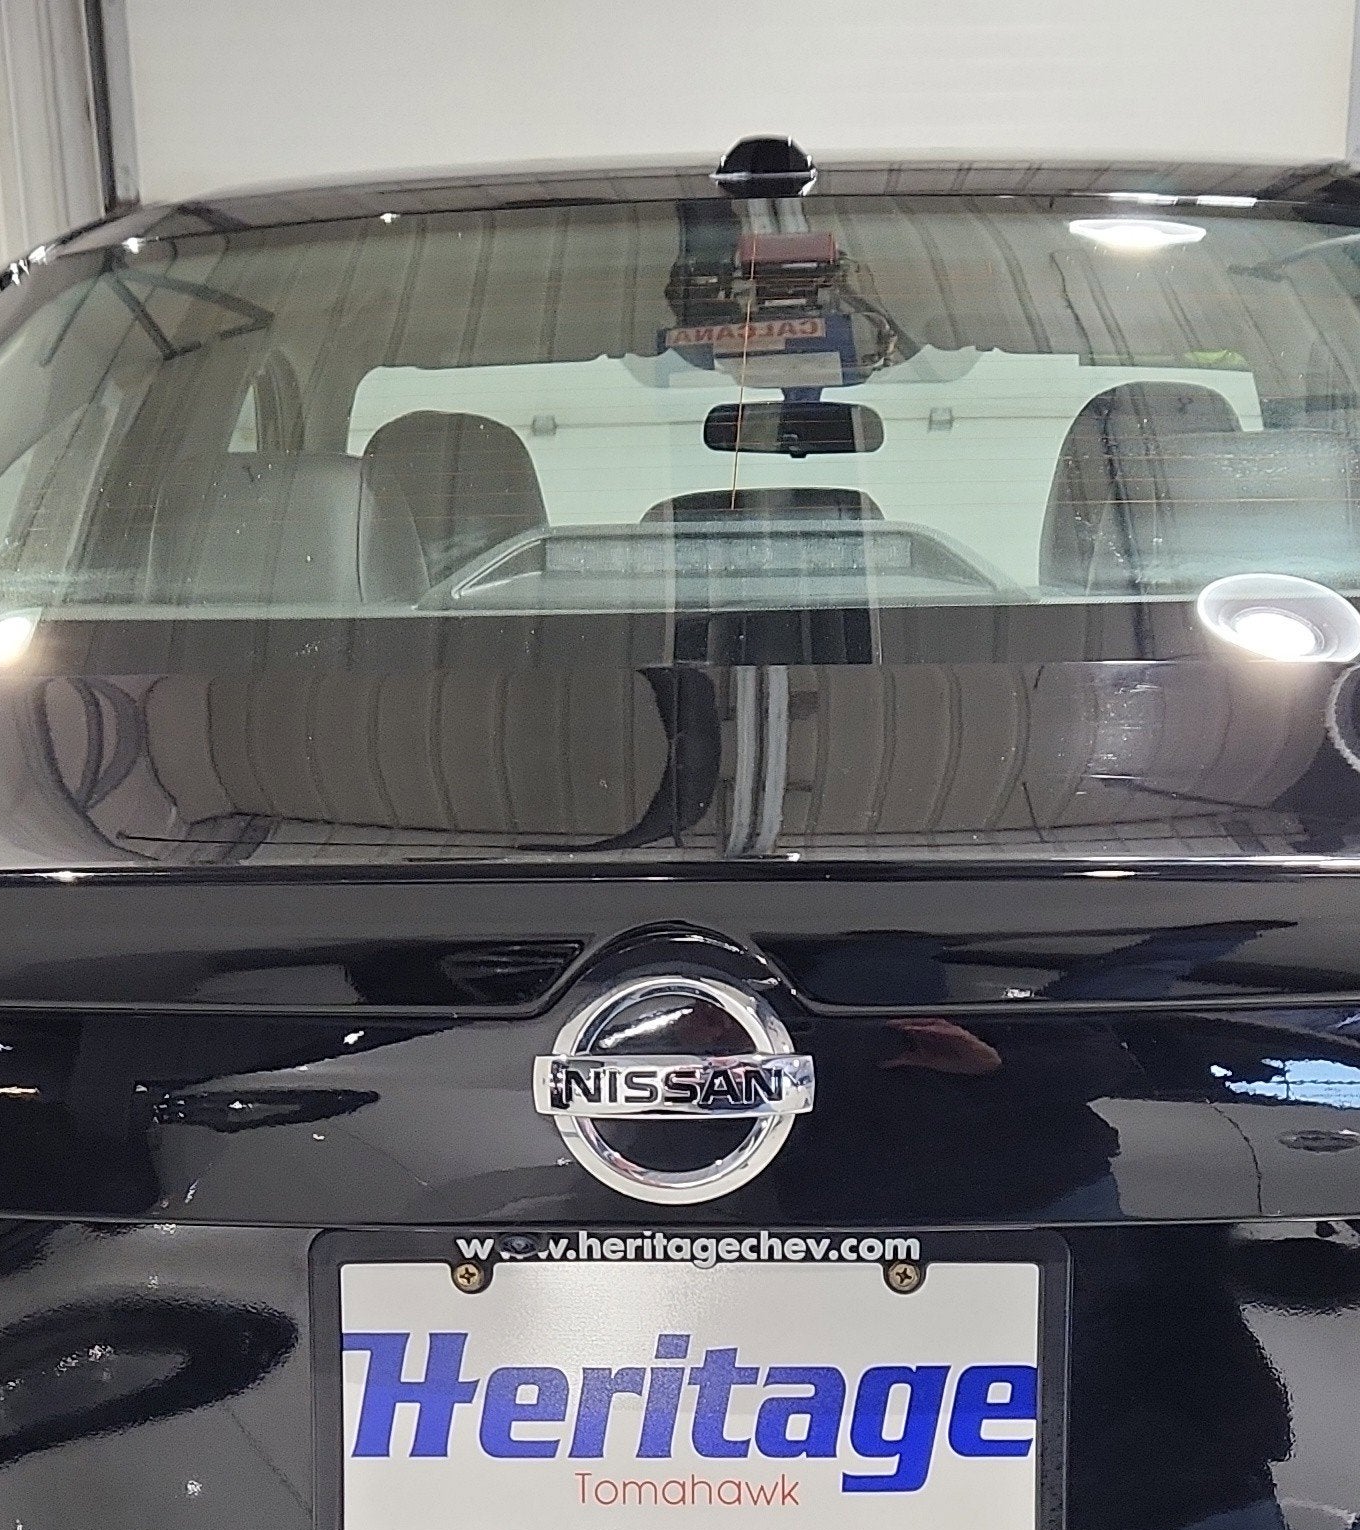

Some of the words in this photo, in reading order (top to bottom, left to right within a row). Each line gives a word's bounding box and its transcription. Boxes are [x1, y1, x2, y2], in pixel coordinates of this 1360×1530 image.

[561, 1066, 784, 1105] NISSAN
[455, 1230, 921, 1269] ww.heritagechev.com
[341, 1331, 1039, 1493] Heritage
[575, 1472, 800, 1507] Tomahawk
